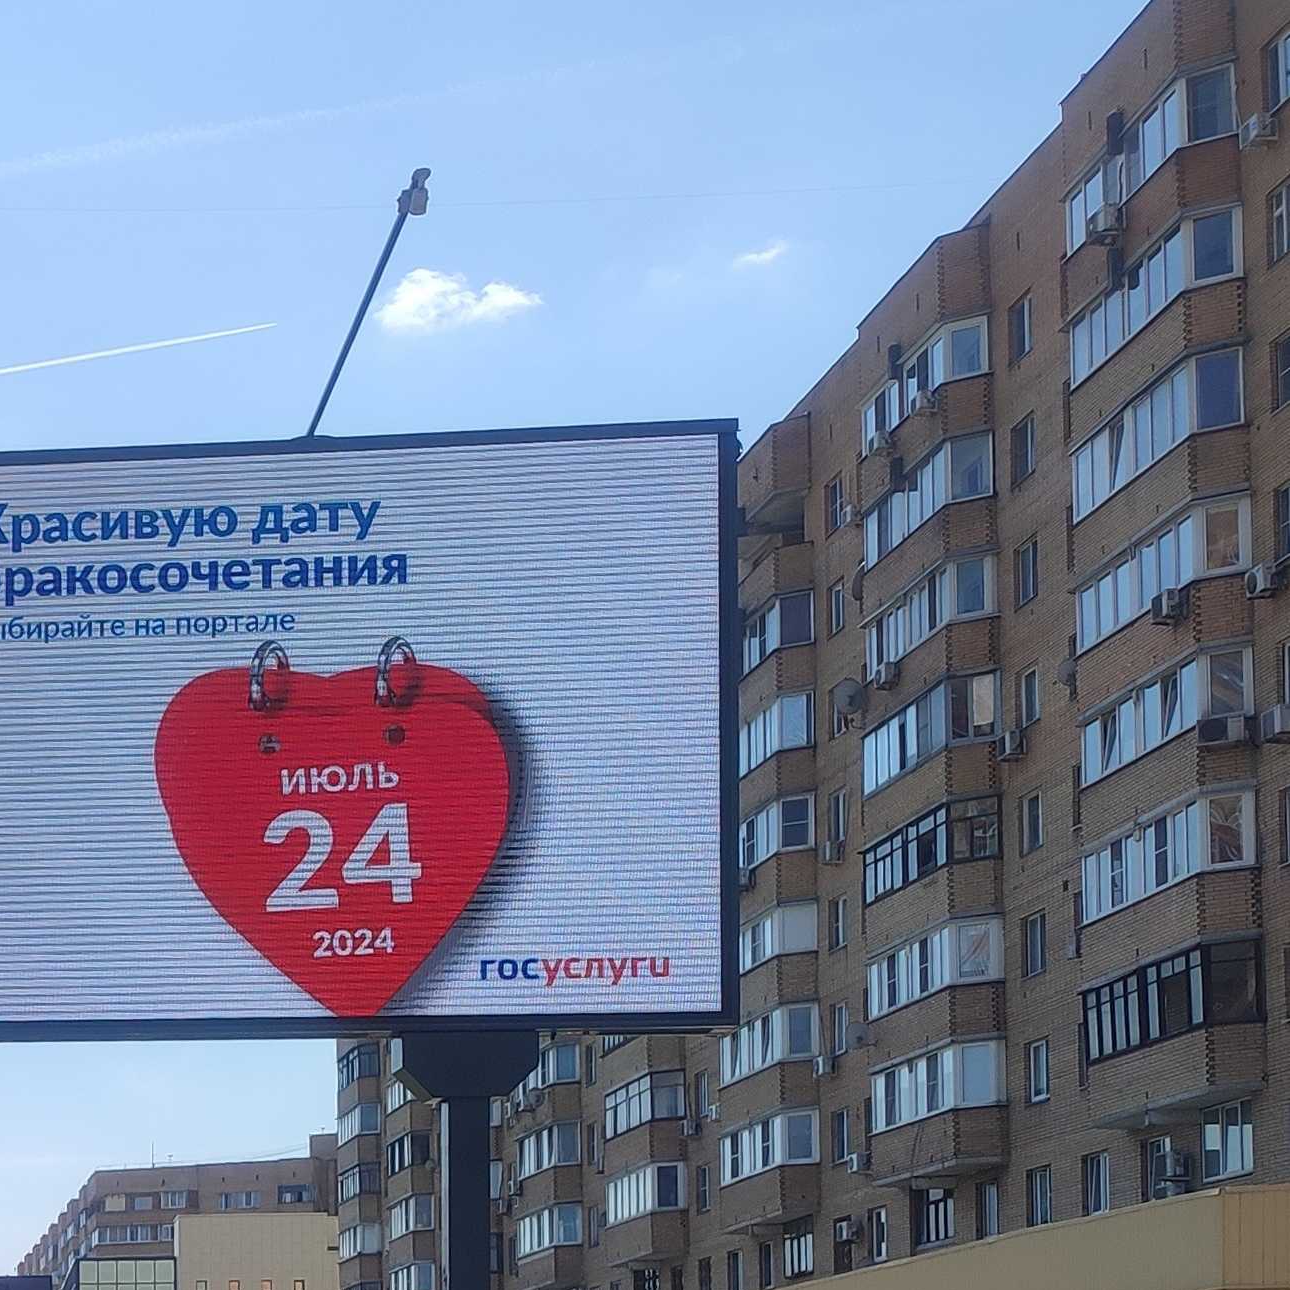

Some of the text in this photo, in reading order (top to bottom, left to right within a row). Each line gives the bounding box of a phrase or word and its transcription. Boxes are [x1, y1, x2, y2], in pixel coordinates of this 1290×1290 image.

[251, 498, 381, 542] дату
[134, 616, 167, 637] на
[175, 610, 296, 640] портале
[262, 802, 422, 914] 24
[312, 927, 395, 959] 2024
